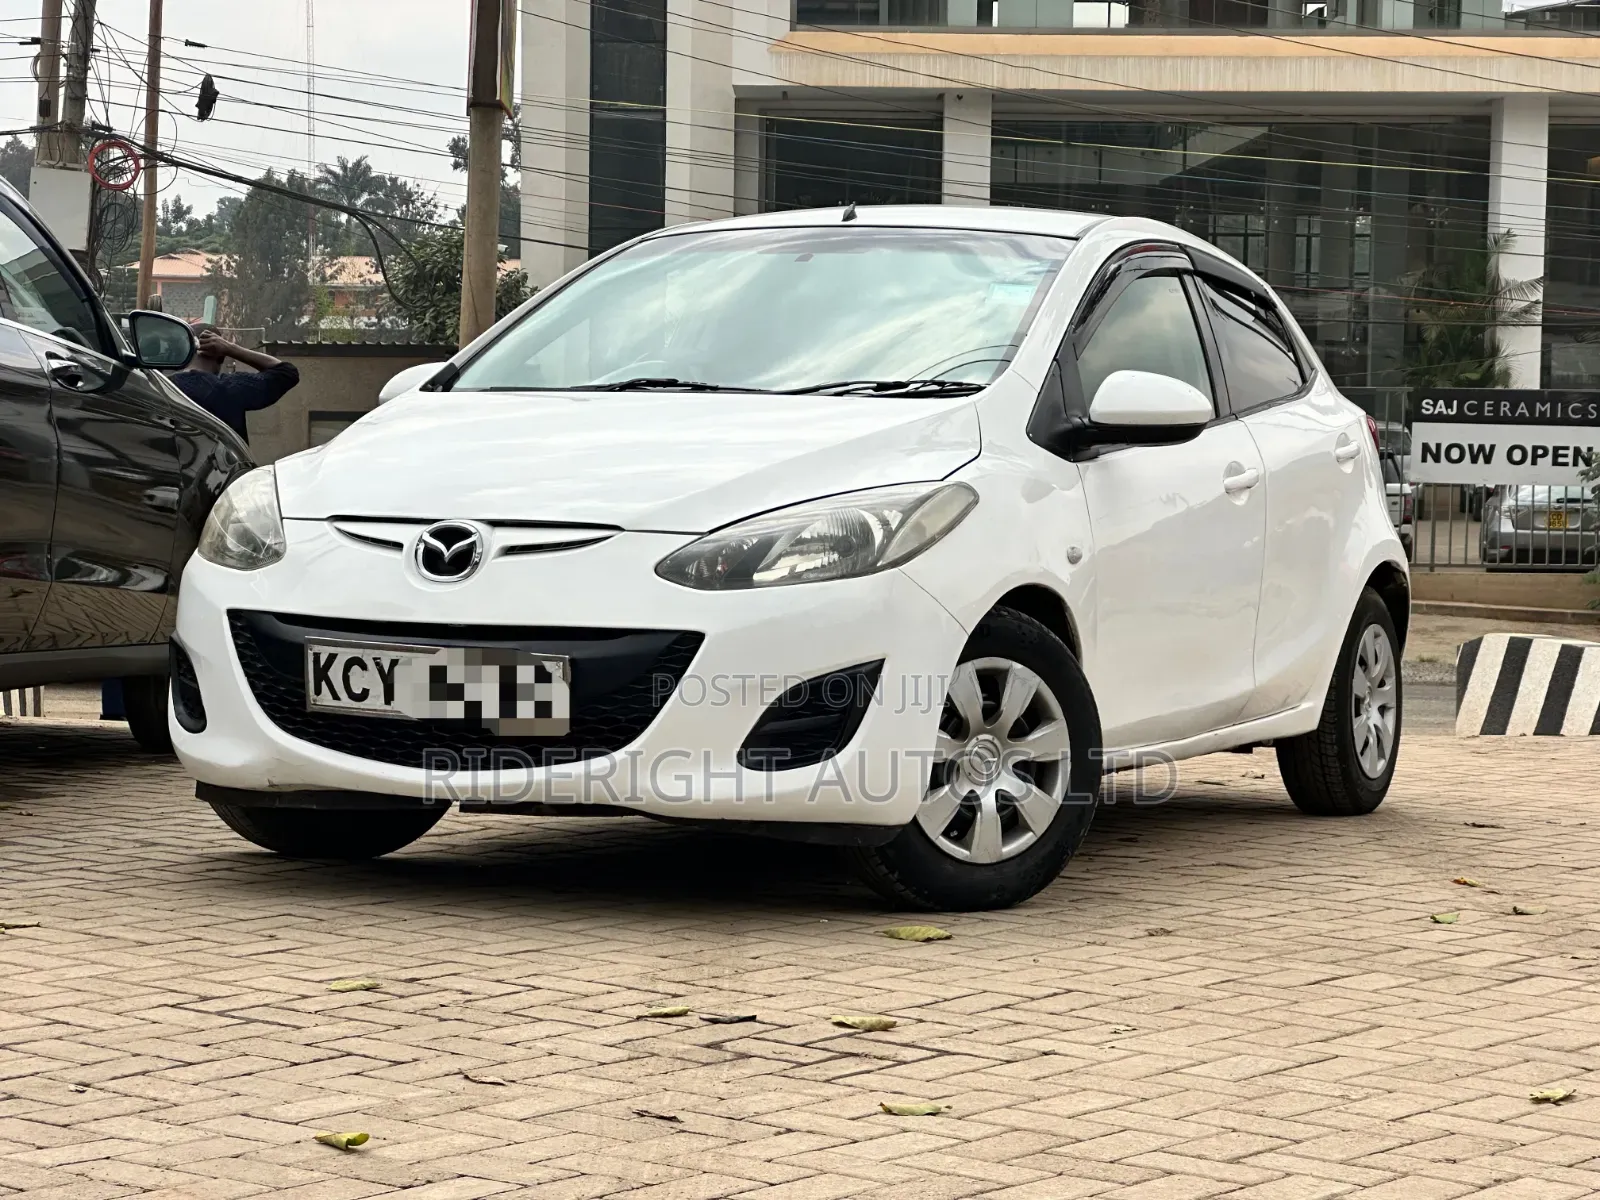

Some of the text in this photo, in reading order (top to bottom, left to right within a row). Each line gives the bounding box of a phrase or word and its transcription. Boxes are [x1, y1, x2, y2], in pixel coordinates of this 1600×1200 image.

[1421, 399, 1597, 419] SAJ CERAMICS
[1420, 442, 1594, 467] NOW OPEN
[312, 651, 399, 706] KCY
